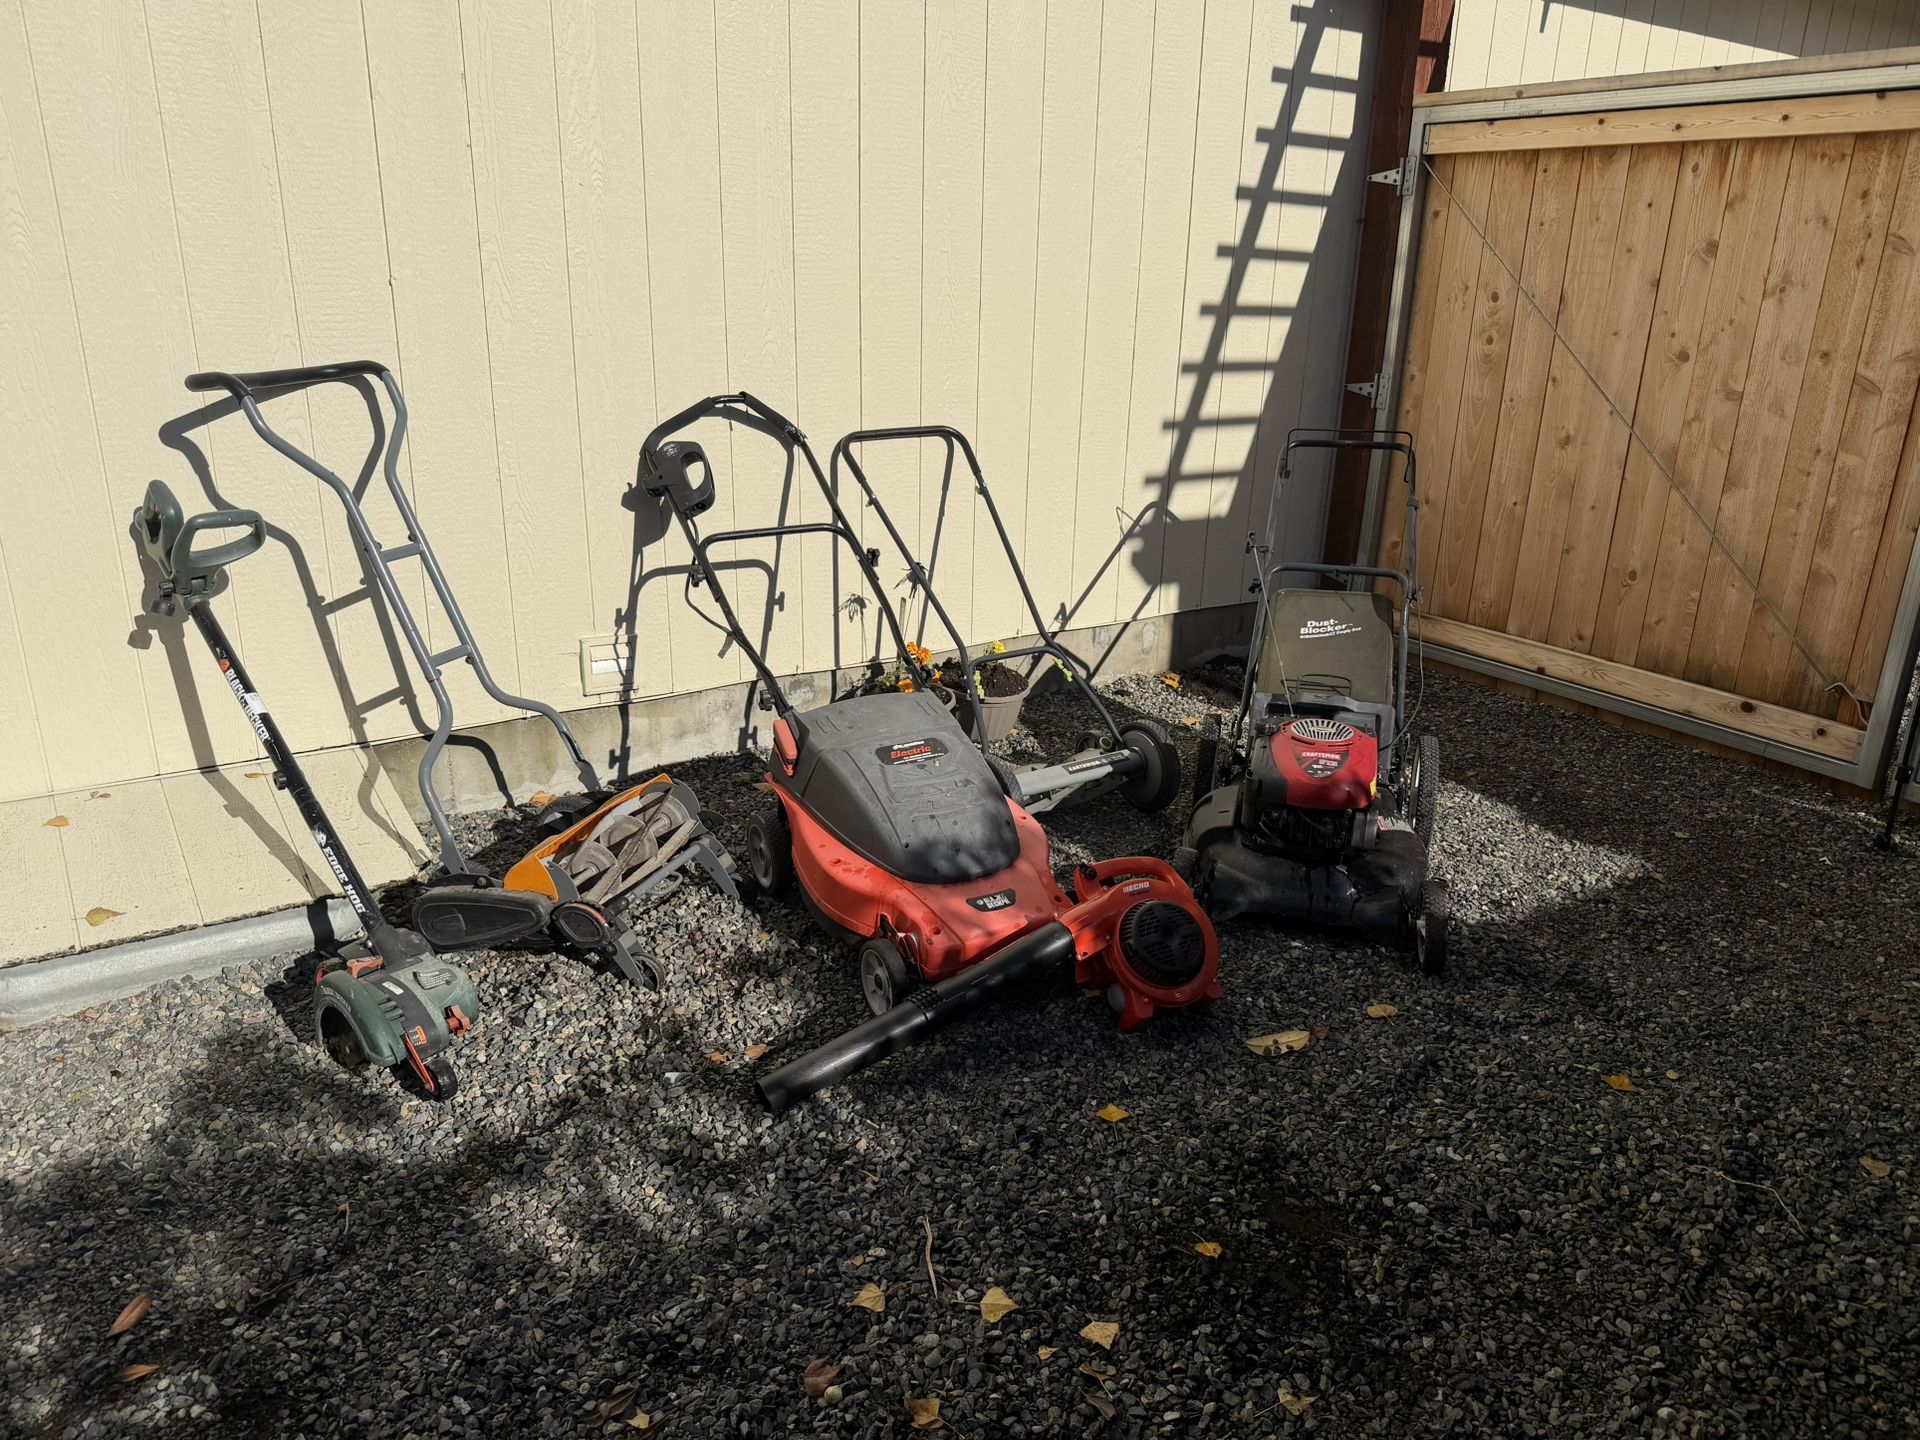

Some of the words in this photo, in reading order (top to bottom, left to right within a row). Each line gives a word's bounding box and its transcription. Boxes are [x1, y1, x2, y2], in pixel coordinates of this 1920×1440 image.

[890, 745, 932, 759] Electric
[1302, 751, 1341, 760] CRAFTSMAN
[323, 846, 349, 883] EDGE
[344, 883, 367, 914] HOG
[1129, 881, 1150, 892] ECHO
